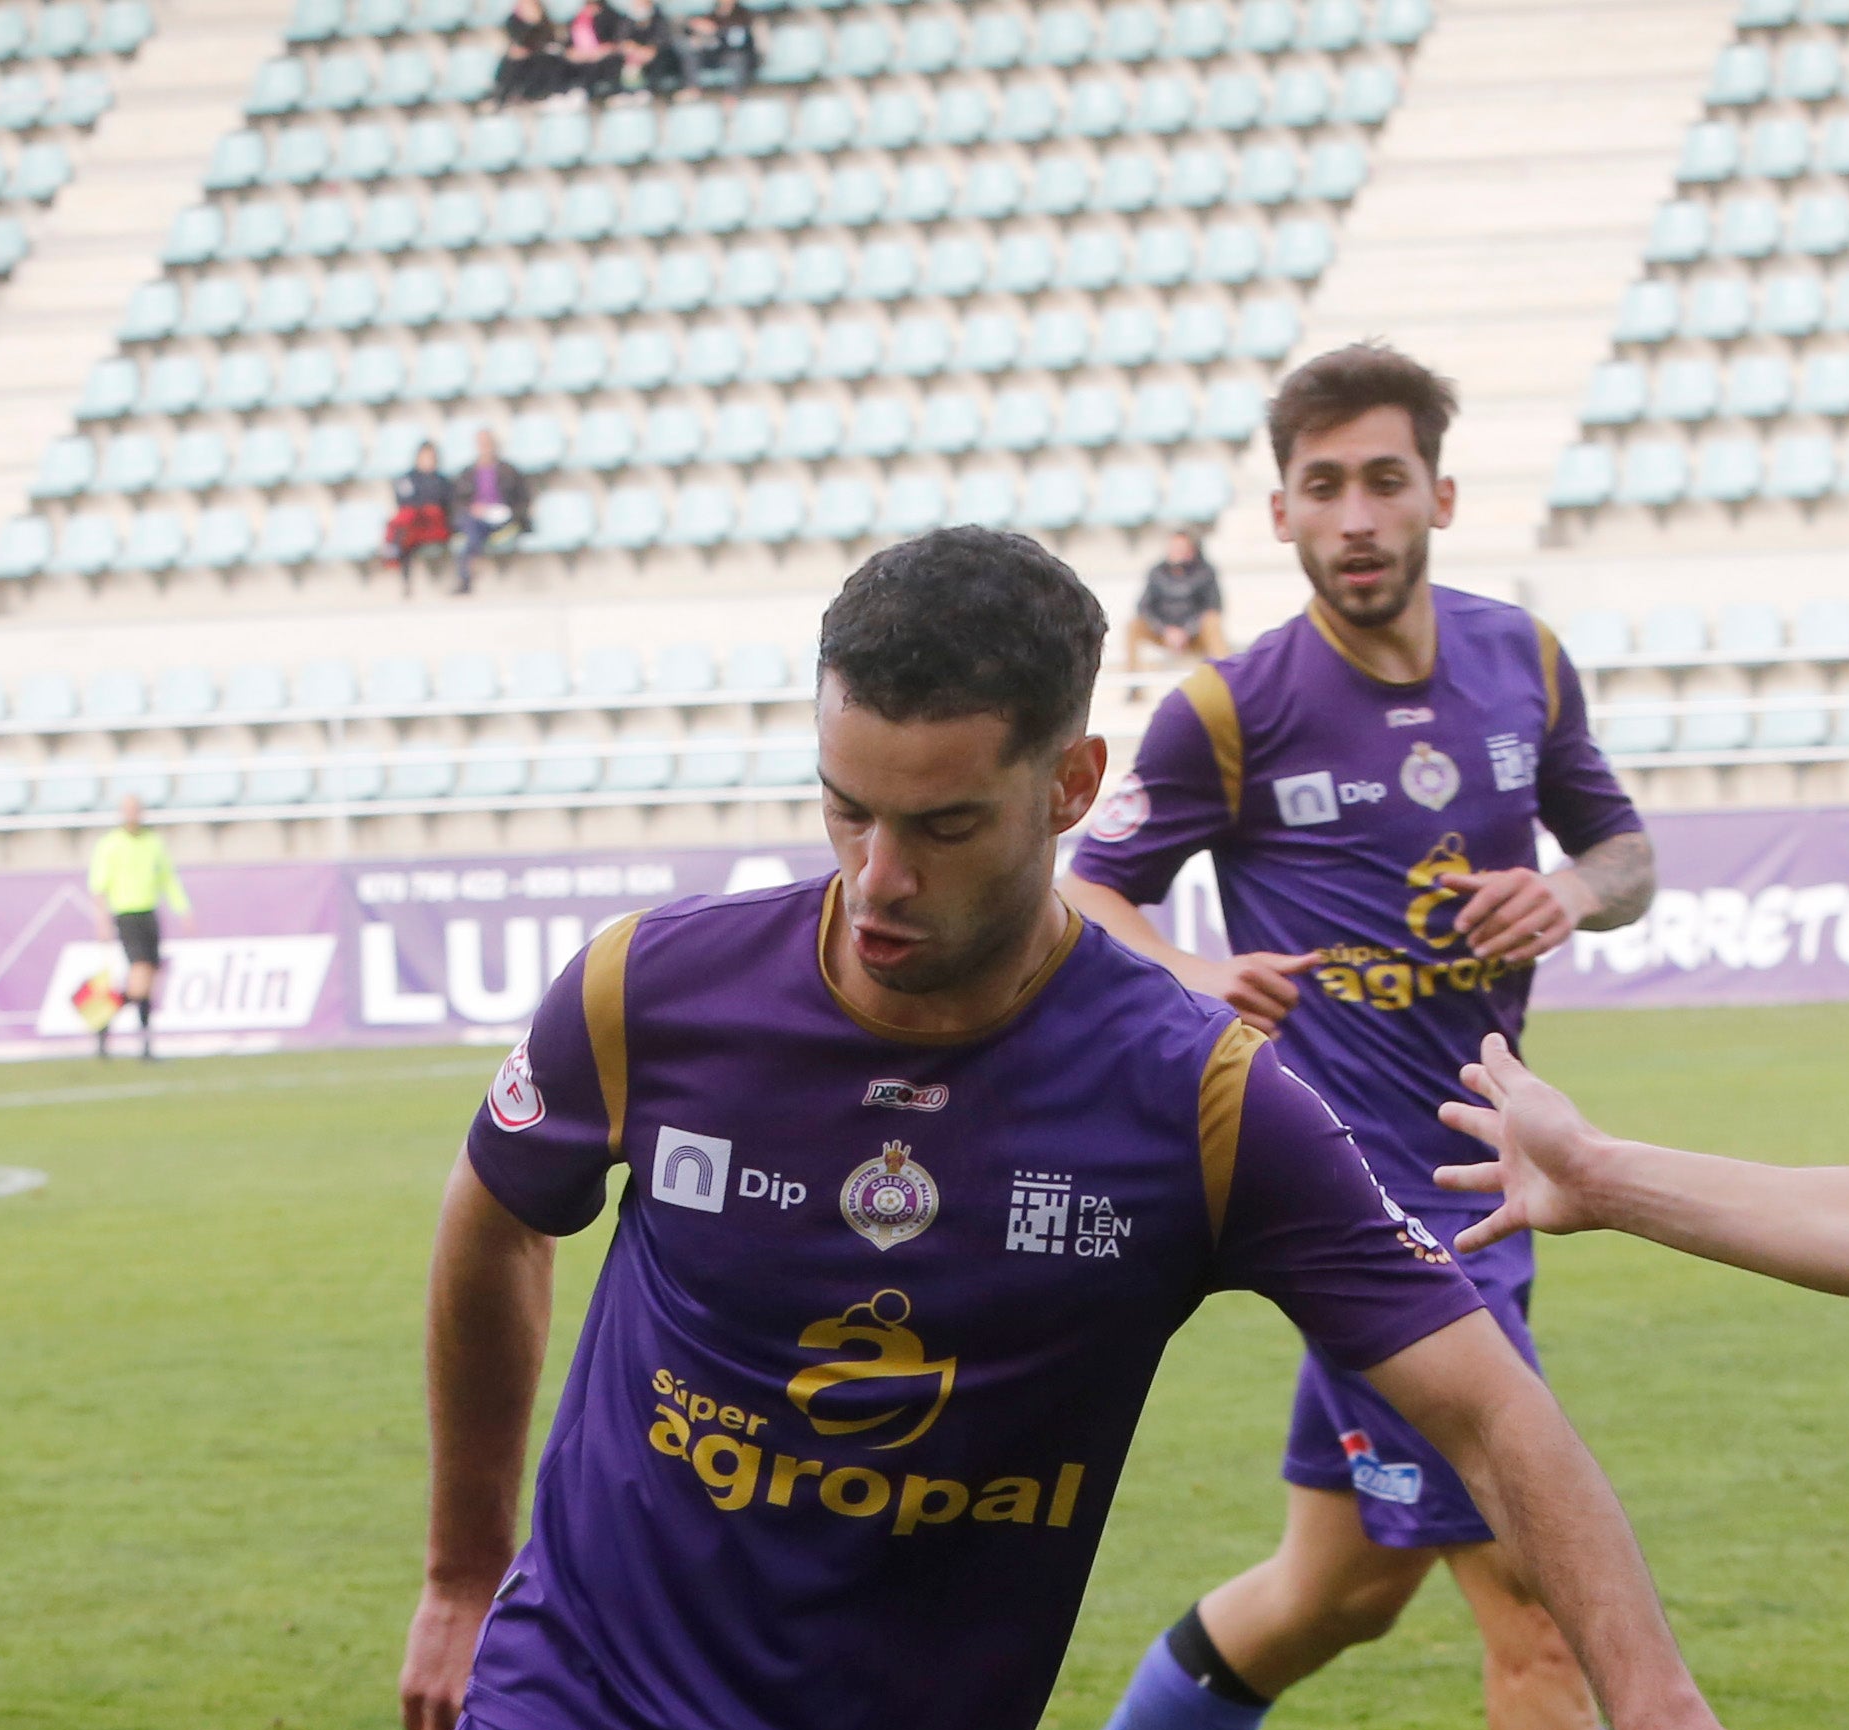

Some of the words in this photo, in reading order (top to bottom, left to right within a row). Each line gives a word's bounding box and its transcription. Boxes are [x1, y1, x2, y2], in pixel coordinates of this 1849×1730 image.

[738, 1168, 807, 1210] Dip
[871, 1176, 913, 1195] CRISTO
[1077, 1194, 1116, 1216] PA
[1076, 1216, 1132, 1238] LEN
[1074, 1236, 1121, 1259] CIA
[649, 1403, 1085, 1536] agropal
